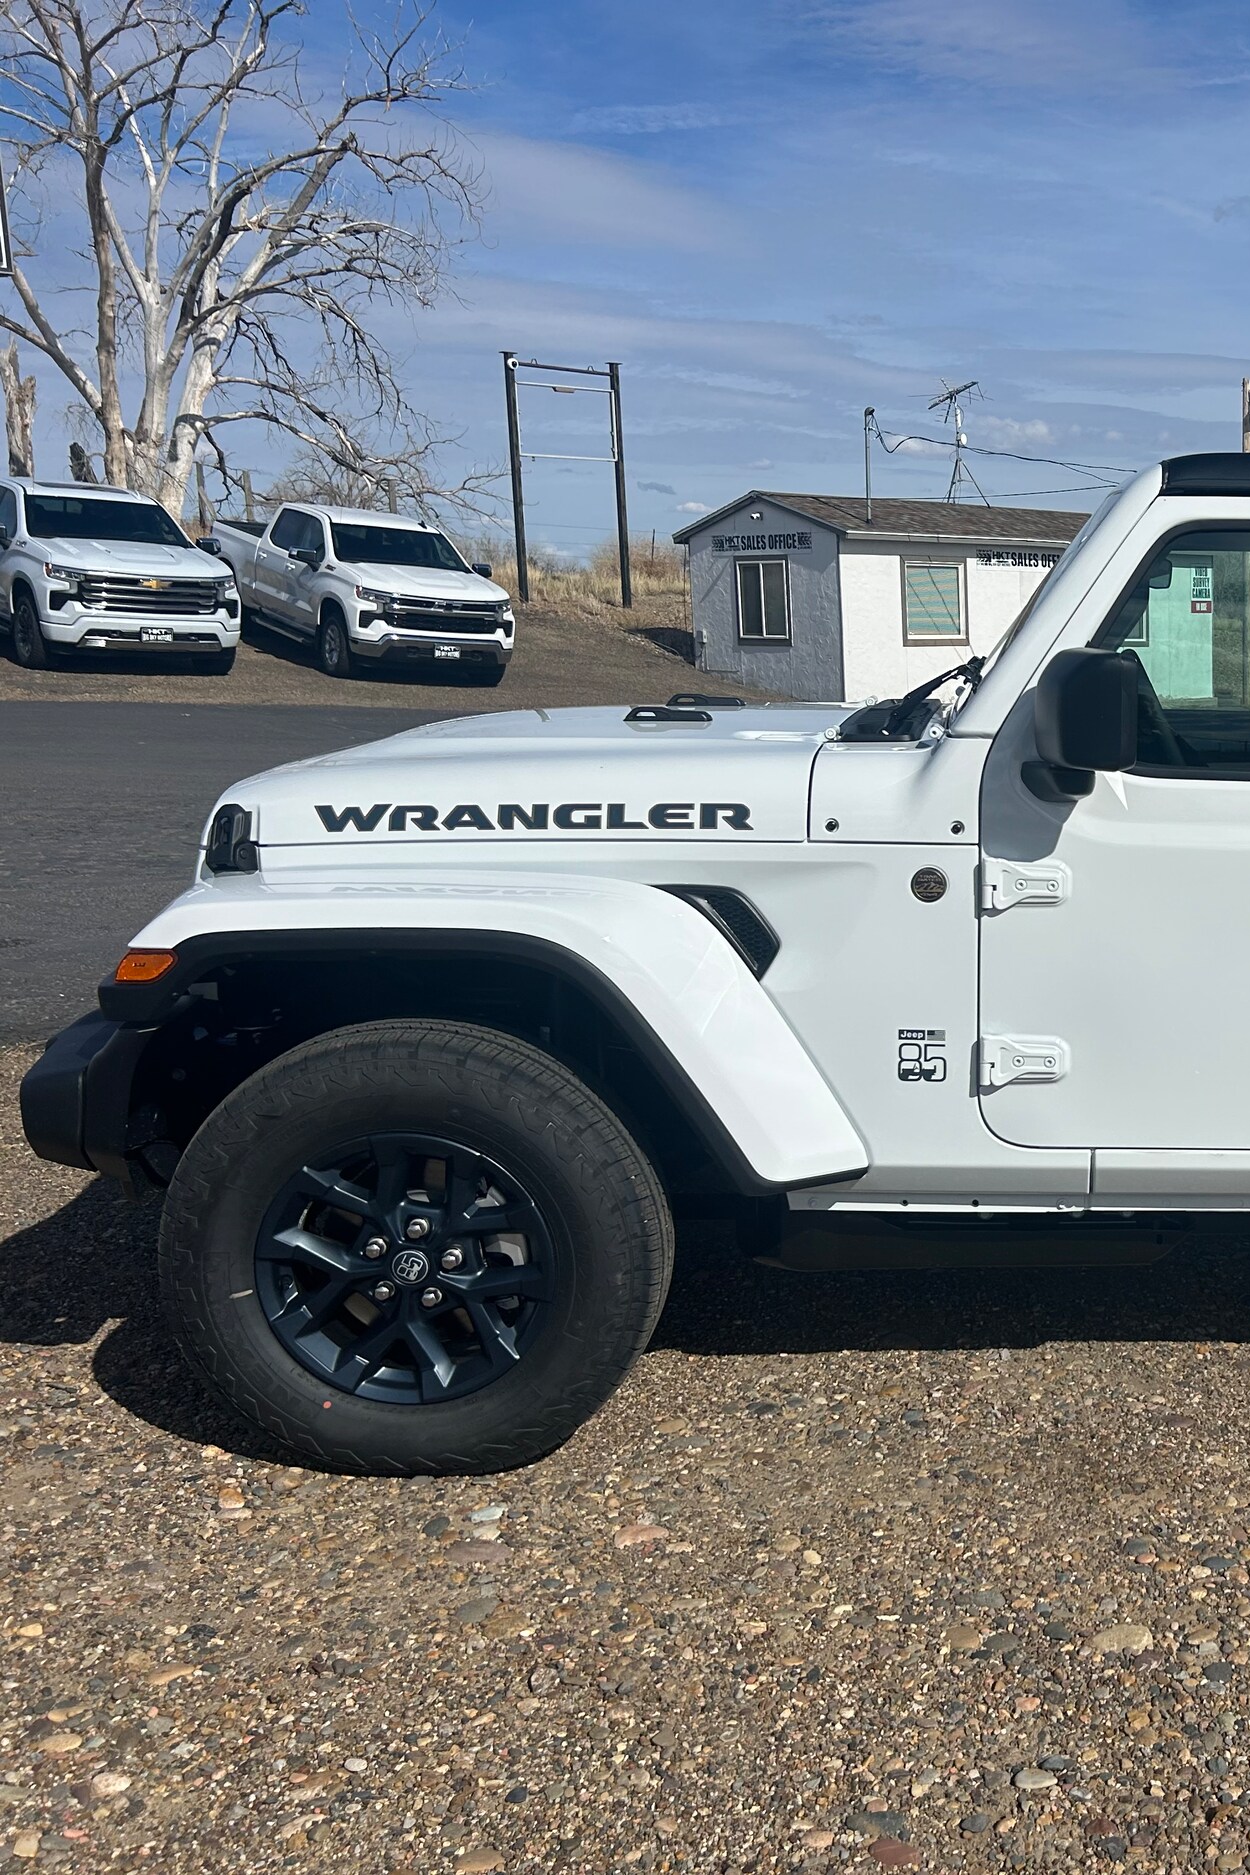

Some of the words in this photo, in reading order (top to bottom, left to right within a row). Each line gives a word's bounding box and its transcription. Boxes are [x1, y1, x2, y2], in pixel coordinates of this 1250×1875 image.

[725, 536, 740, 545] HKT
[741, 534, 767, 551] SALES
[768, 533, 797, 550] OFFICE
[992, 551, 1010, 560] HKT
[1010, 552, 1039, 567] SALES
[1041, 553, 1060, 568] OFF
[1193, 577, 1210, 588] SURVEY
[1192, 588, 1210, 598] CAMERA
[314, 803, 755, 833] WRANGLER
[900, 1031, 924, 1039] Jeep
[898, 1043, 947, 1082] 85
[396, 1254, 424, 1281] 85
